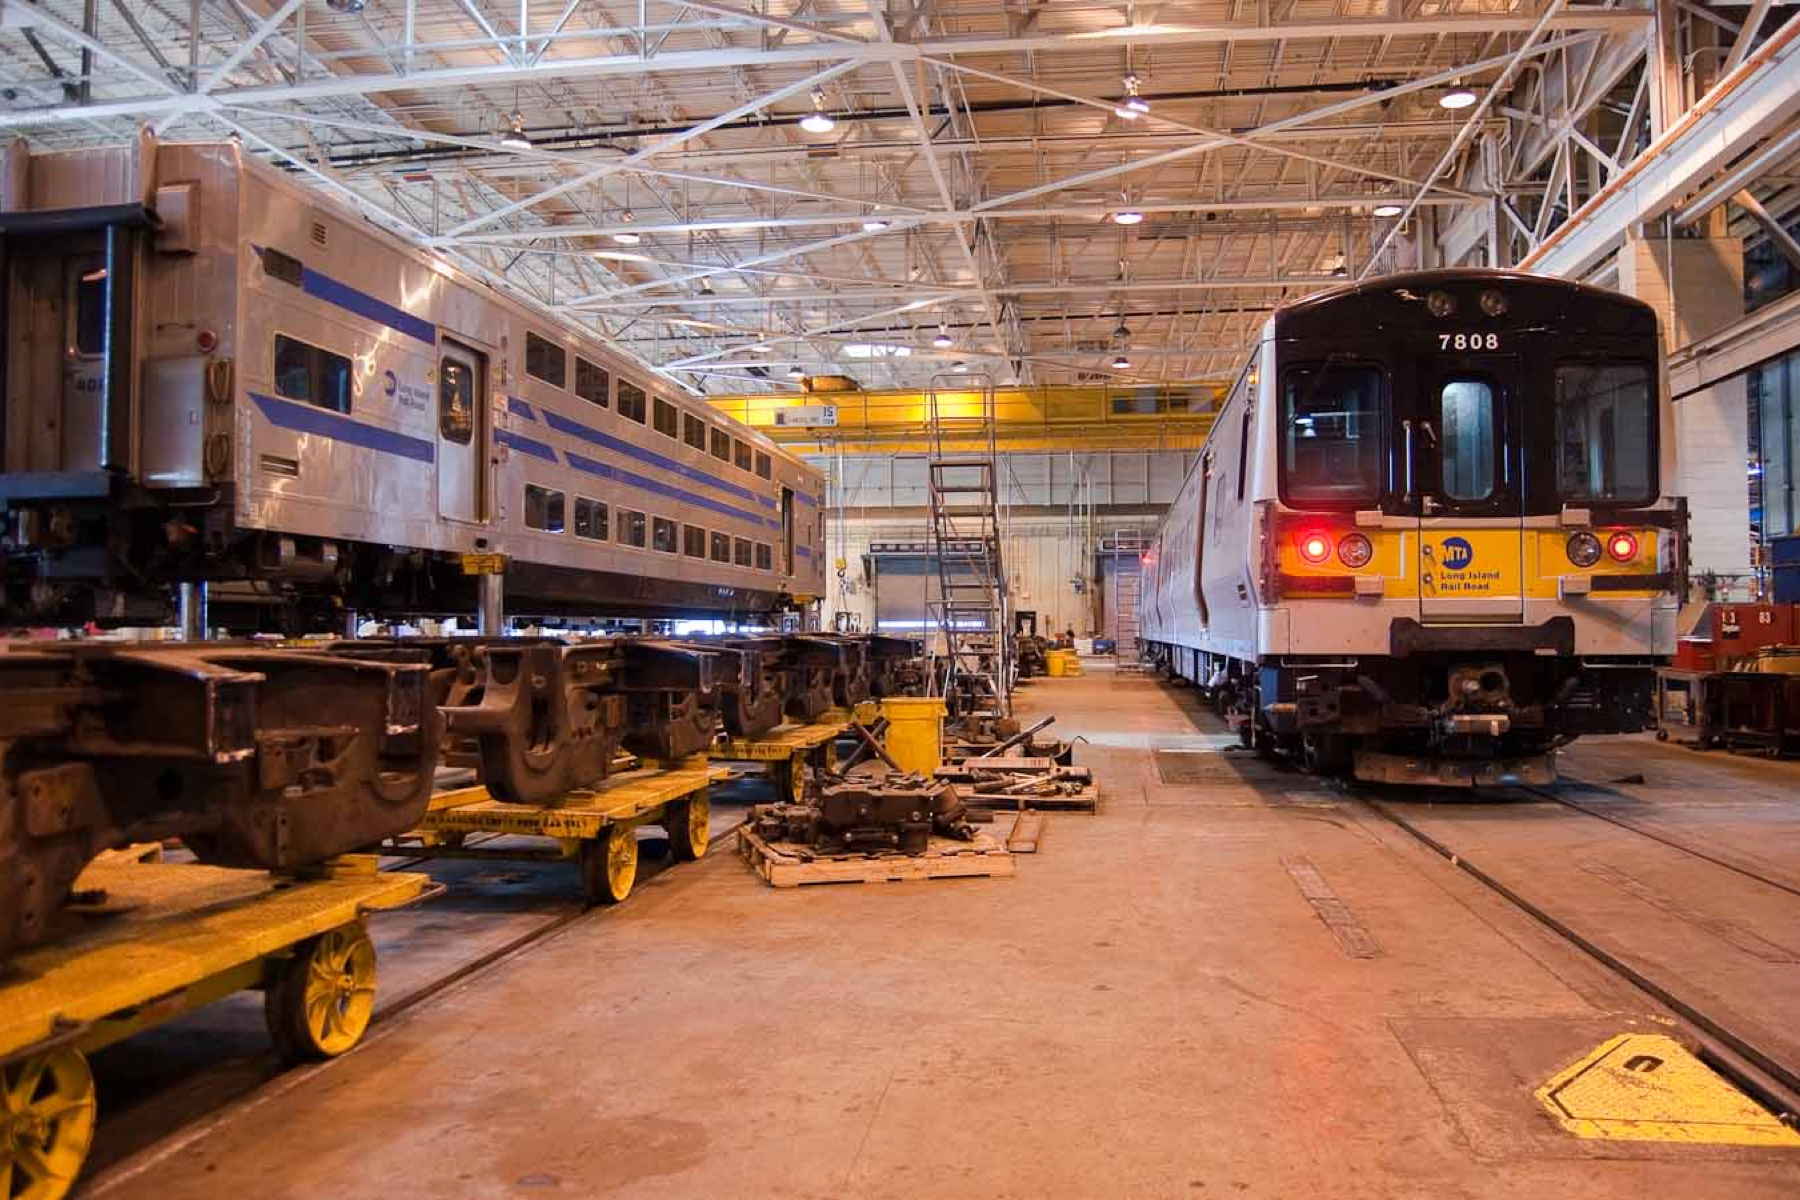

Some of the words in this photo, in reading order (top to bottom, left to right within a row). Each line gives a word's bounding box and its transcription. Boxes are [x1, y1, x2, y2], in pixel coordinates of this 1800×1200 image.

[1439, 333, 1499, 350] 7808
[1440, 571, 1465, 580] Long
[1468, 570, 1501, 580] Island
[1440, 582, 1461, 591] Rail
[1463, 581, 1490, 591] Road
